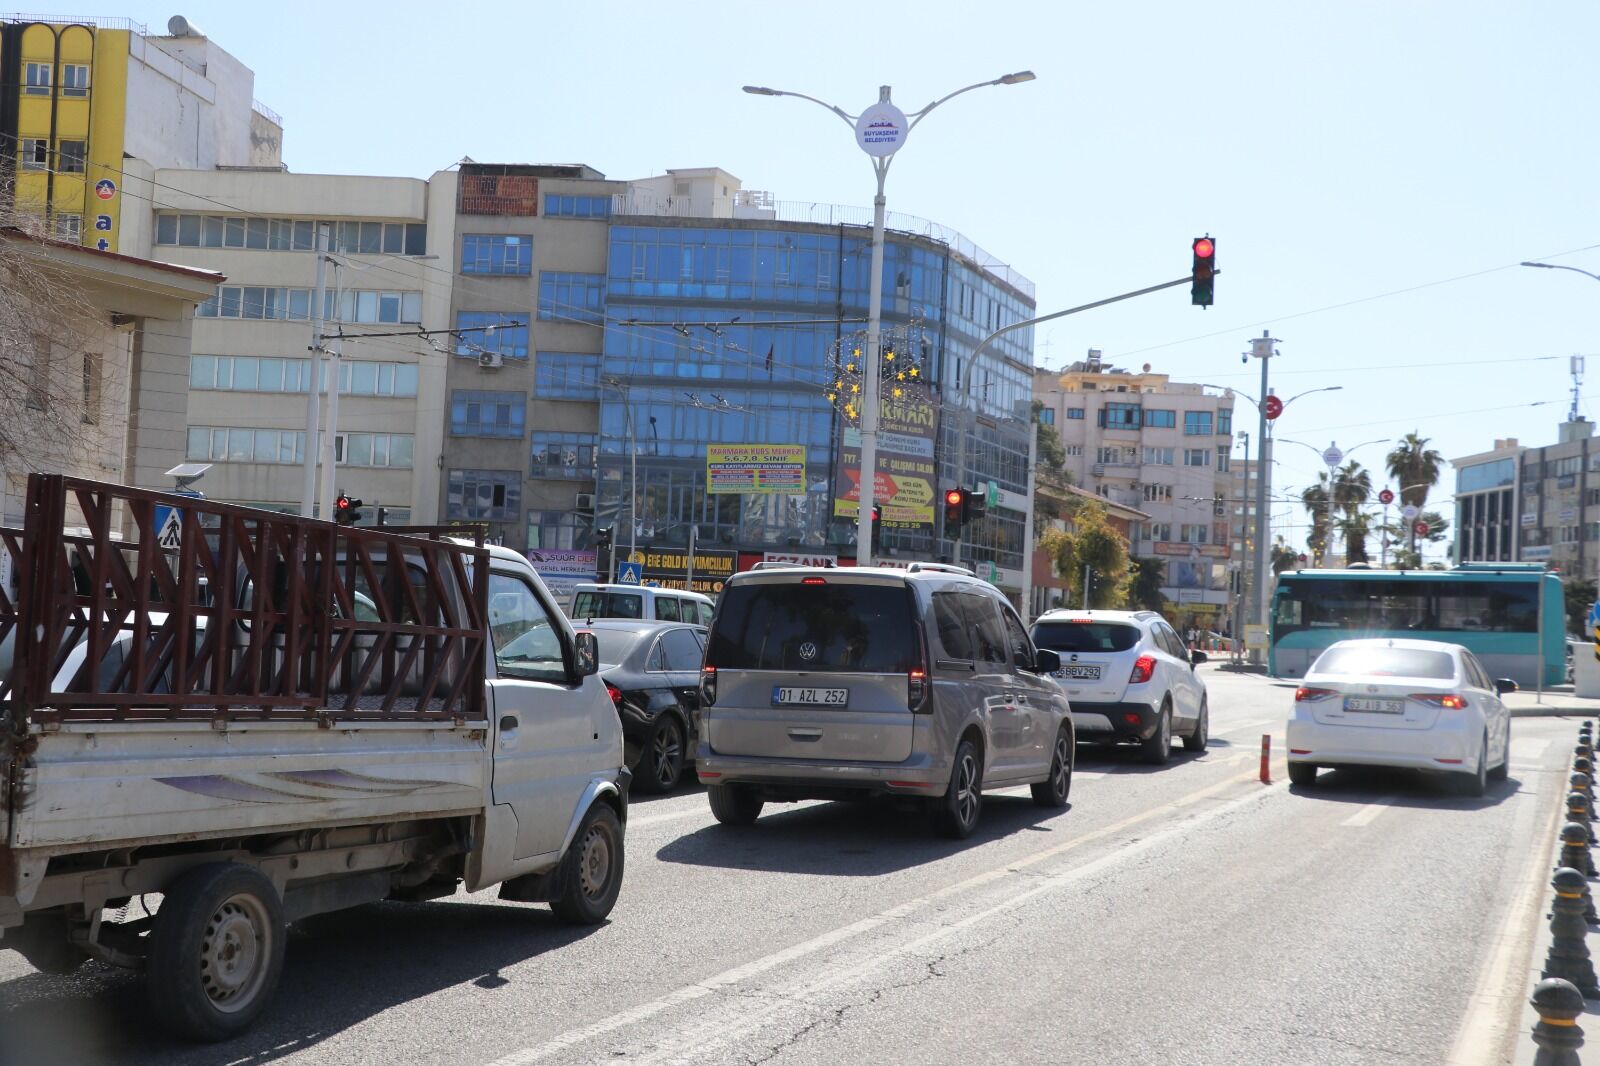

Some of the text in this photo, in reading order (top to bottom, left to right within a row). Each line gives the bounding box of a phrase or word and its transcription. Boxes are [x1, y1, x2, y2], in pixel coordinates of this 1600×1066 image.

[843, 453, 856, 463] TYT
[662, 554, 681, 568] GOLD
[767, 556, 832, 567] ECZAN
[780, 690, 845, 703] 01 AZL 252
